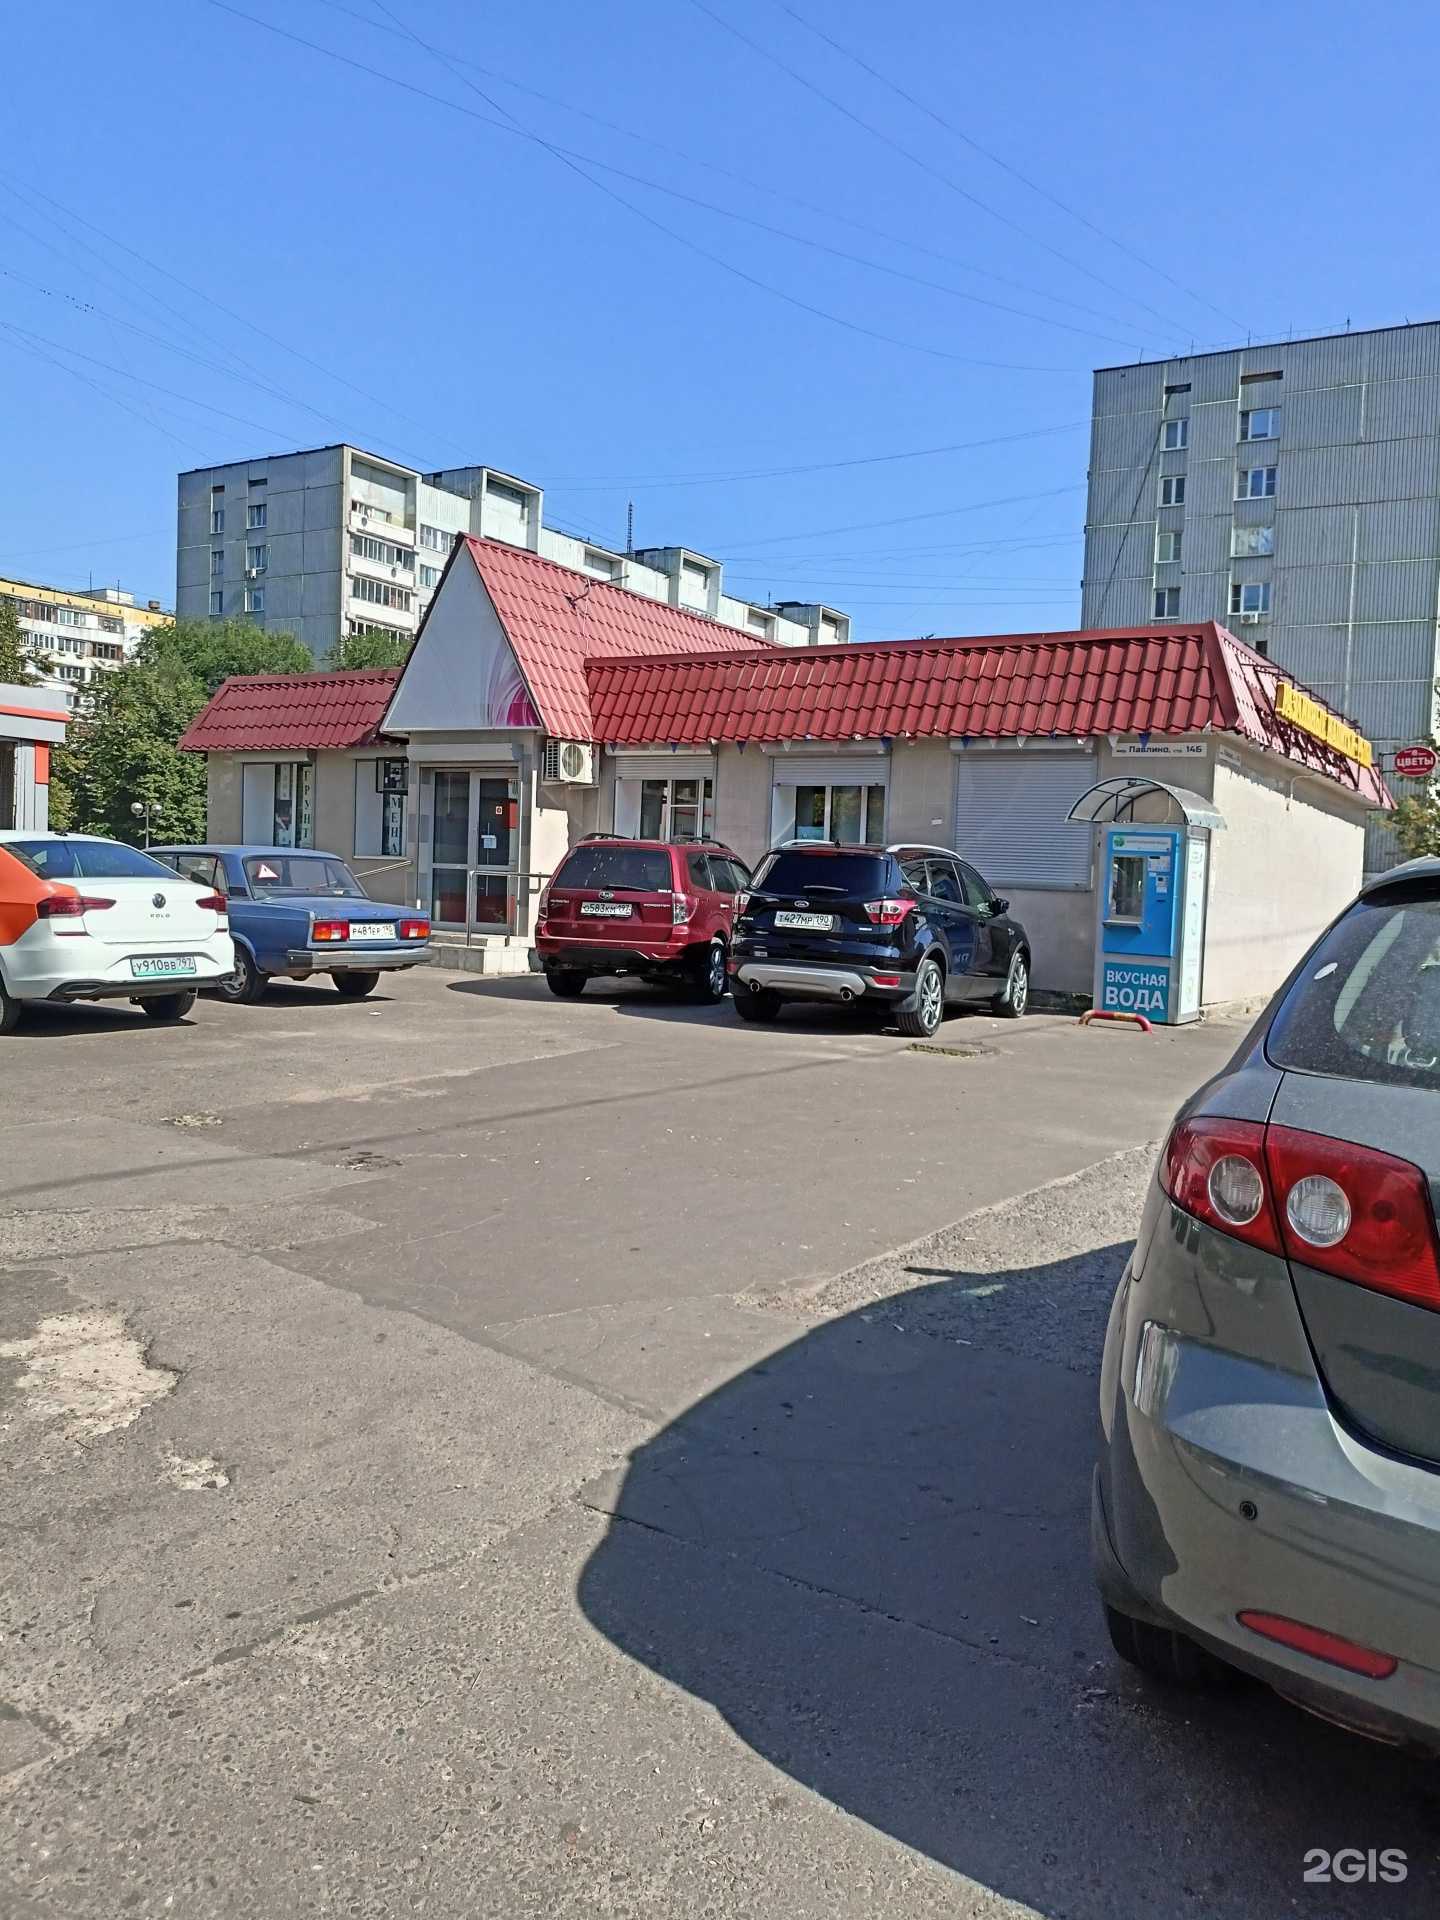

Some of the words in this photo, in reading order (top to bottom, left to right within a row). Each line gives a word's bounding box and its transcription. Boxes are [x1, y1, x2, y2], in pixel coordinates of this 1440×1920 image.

[1396, 756, 1434, 768] ЦВЕТЫ
[1106, 970, 1167, 987] ВКУСНАЯ
[1105, 986, 1165, 1012] ВОДА
